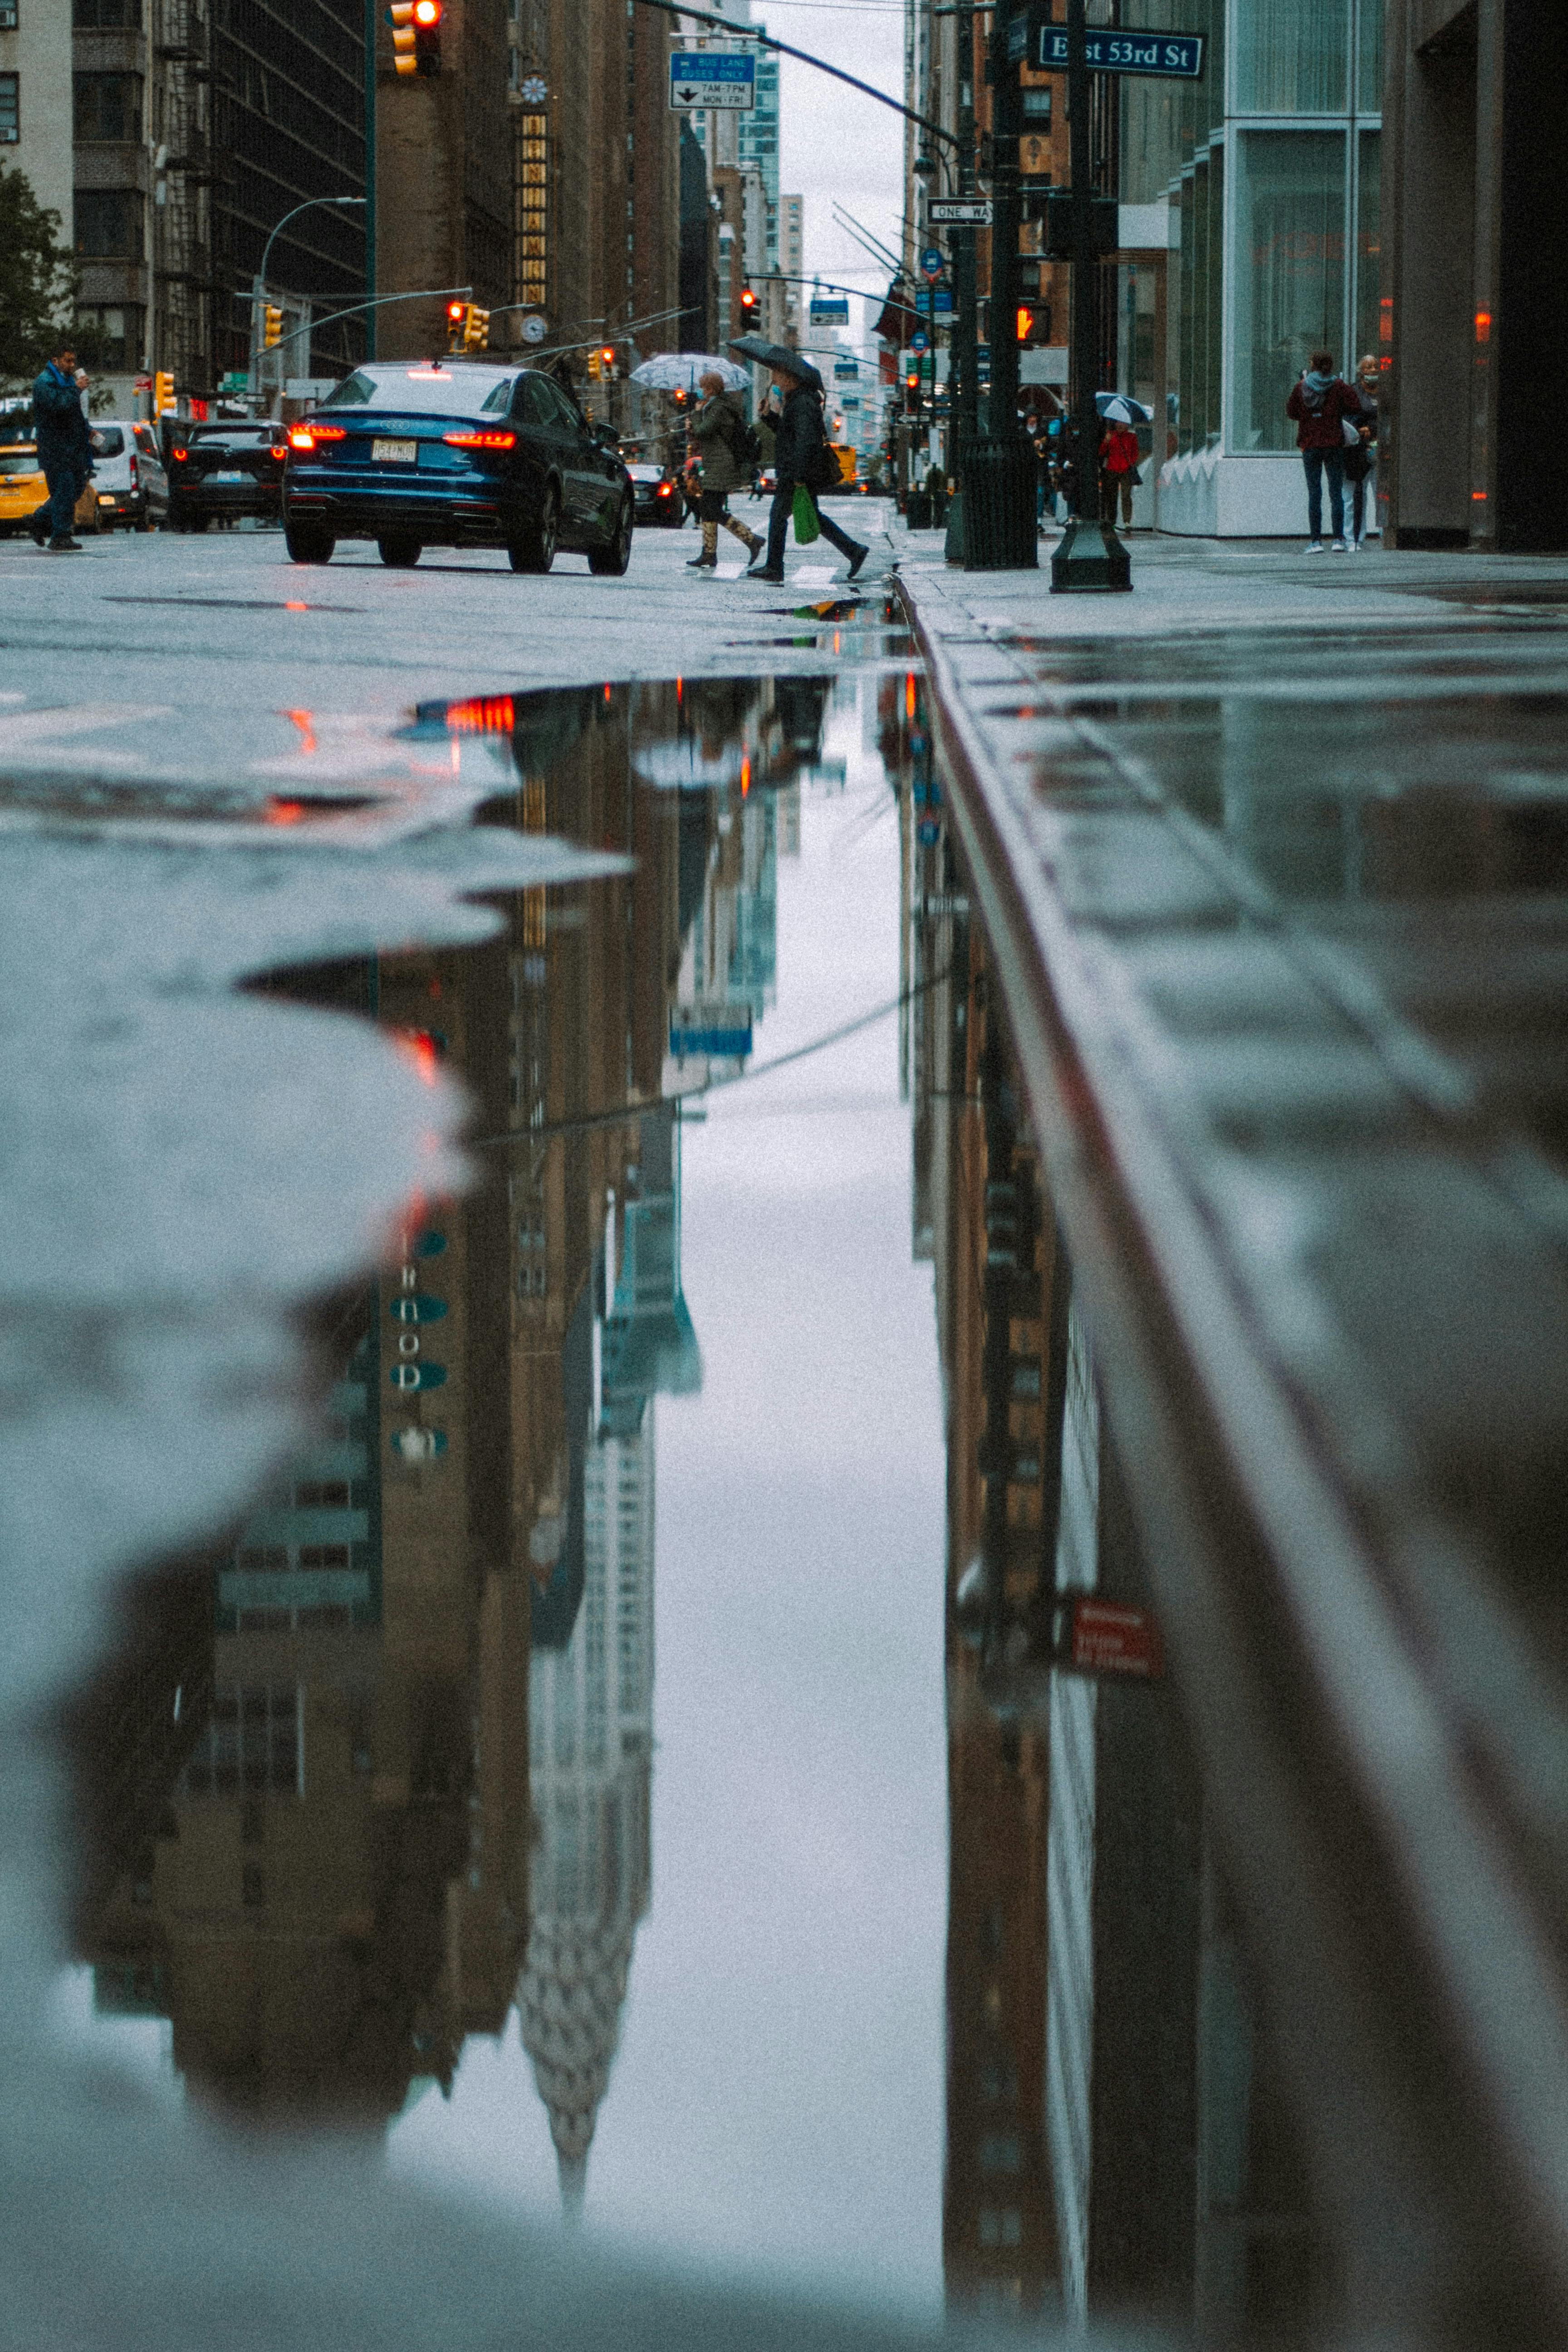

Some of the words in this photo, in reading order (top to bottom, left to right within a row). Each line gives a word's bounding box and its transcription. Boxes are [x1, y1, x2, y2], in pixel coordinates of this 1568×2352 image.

[1051, 36, 1101, 60] Est
[1108, 42, 1157, 64] 53rd
[1165, 45, 1188, 67] St
[698, 58, 717, 67] BUS
[720, 59, 746, 67] LANE
[681, 69, 714, 78] BUSES
[719, 70, 744, 78] ONLY
[938, 207, 962, 217] ONE
